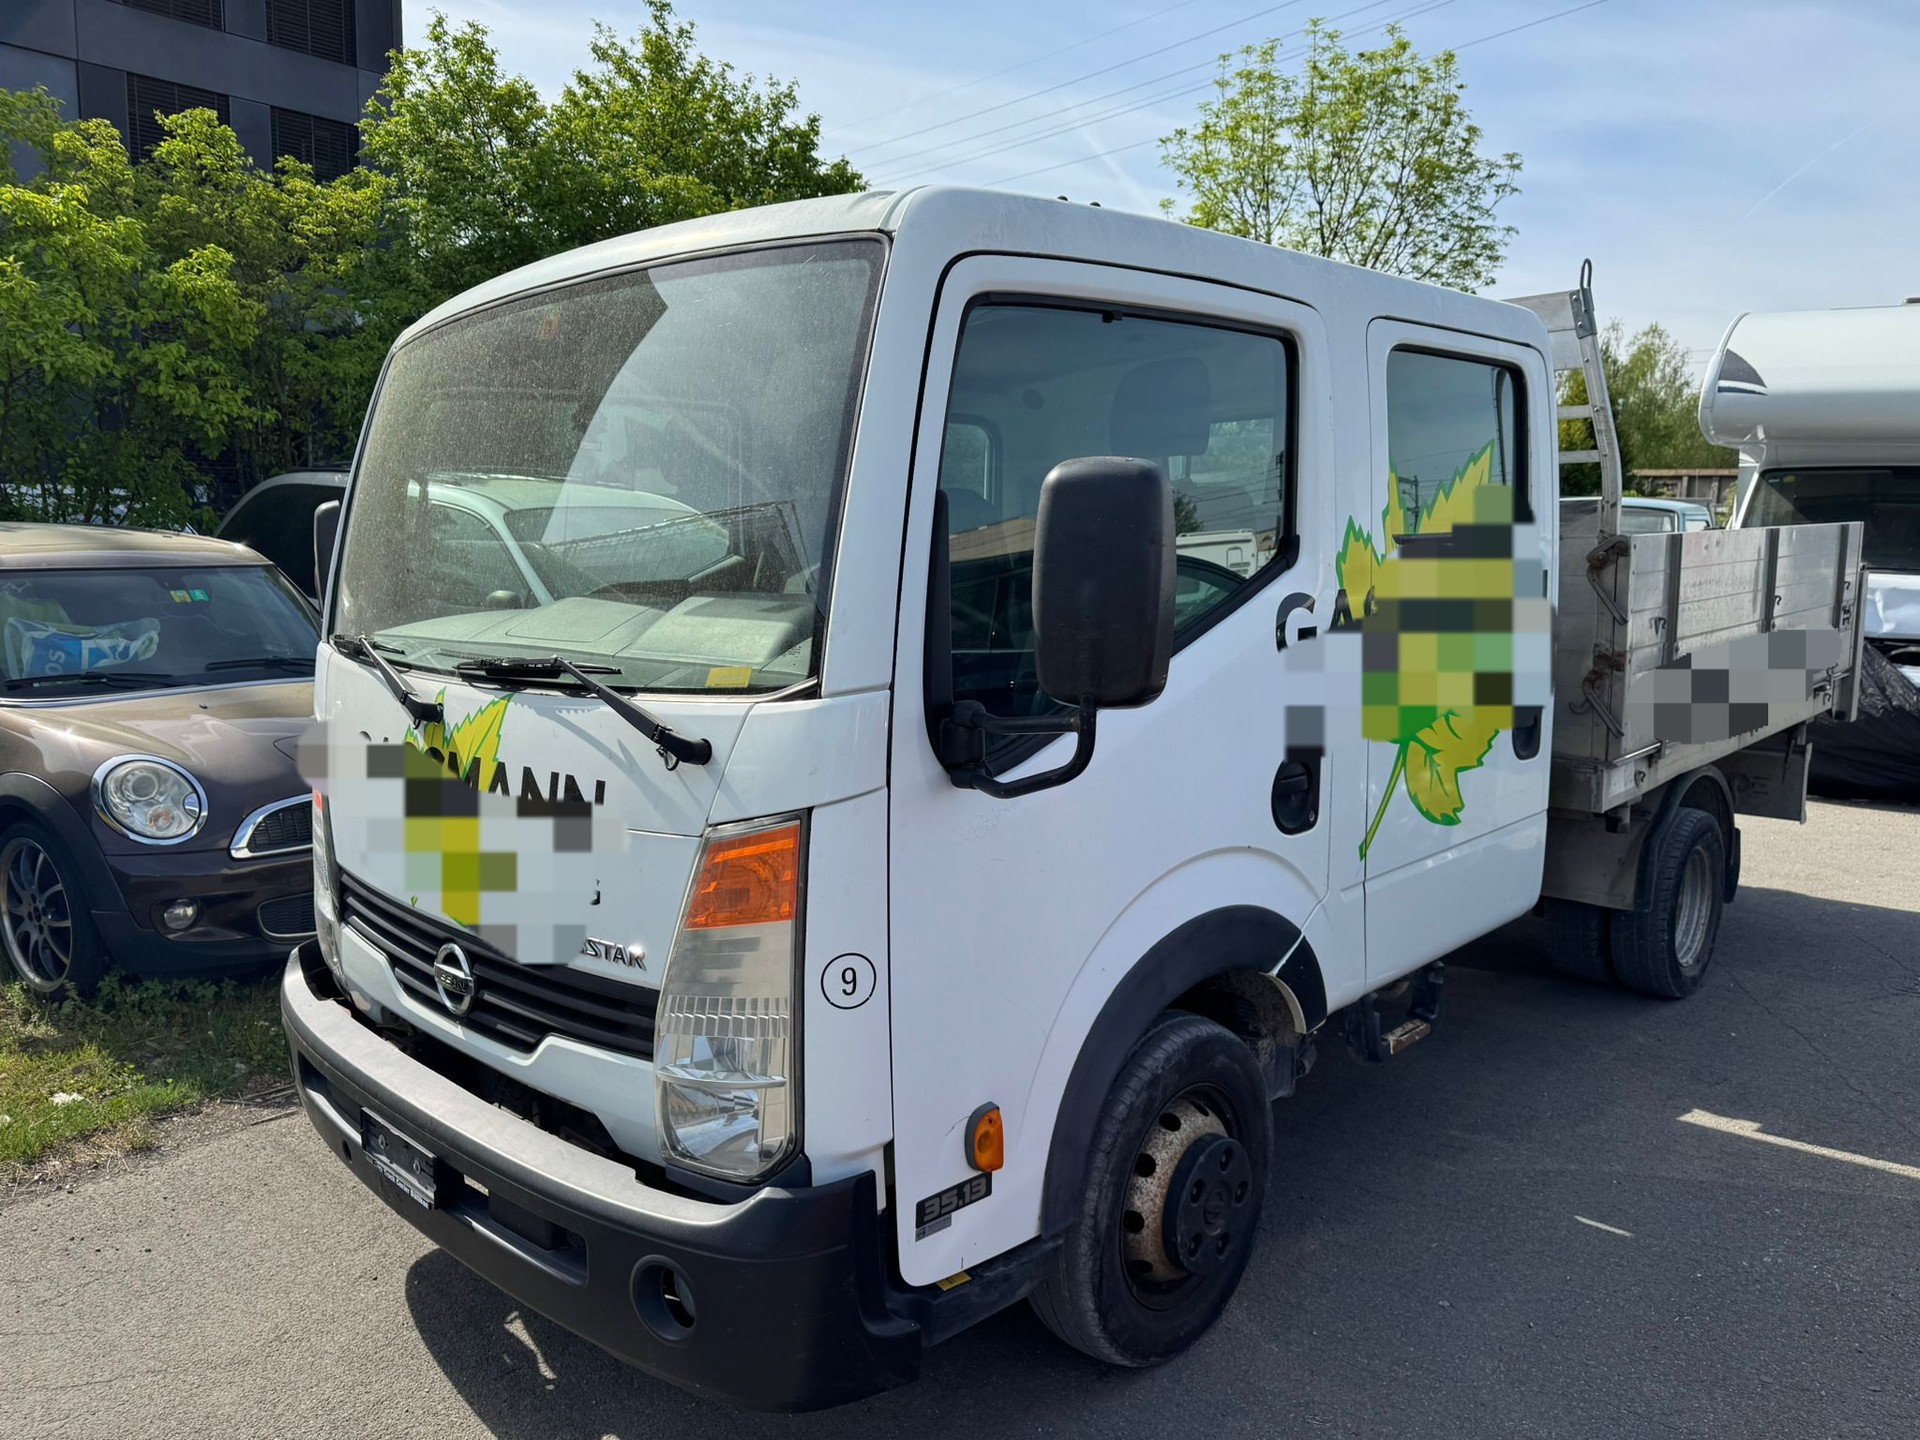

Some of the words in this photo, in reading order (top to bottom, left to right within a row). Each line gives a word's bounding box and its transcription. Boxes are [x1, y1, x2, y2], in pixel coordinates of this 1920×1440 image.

[582, 936, 646, 972] STAR
[841, 967, 857, 996] 9
[923, 1177, 986, 1222] 35.13
